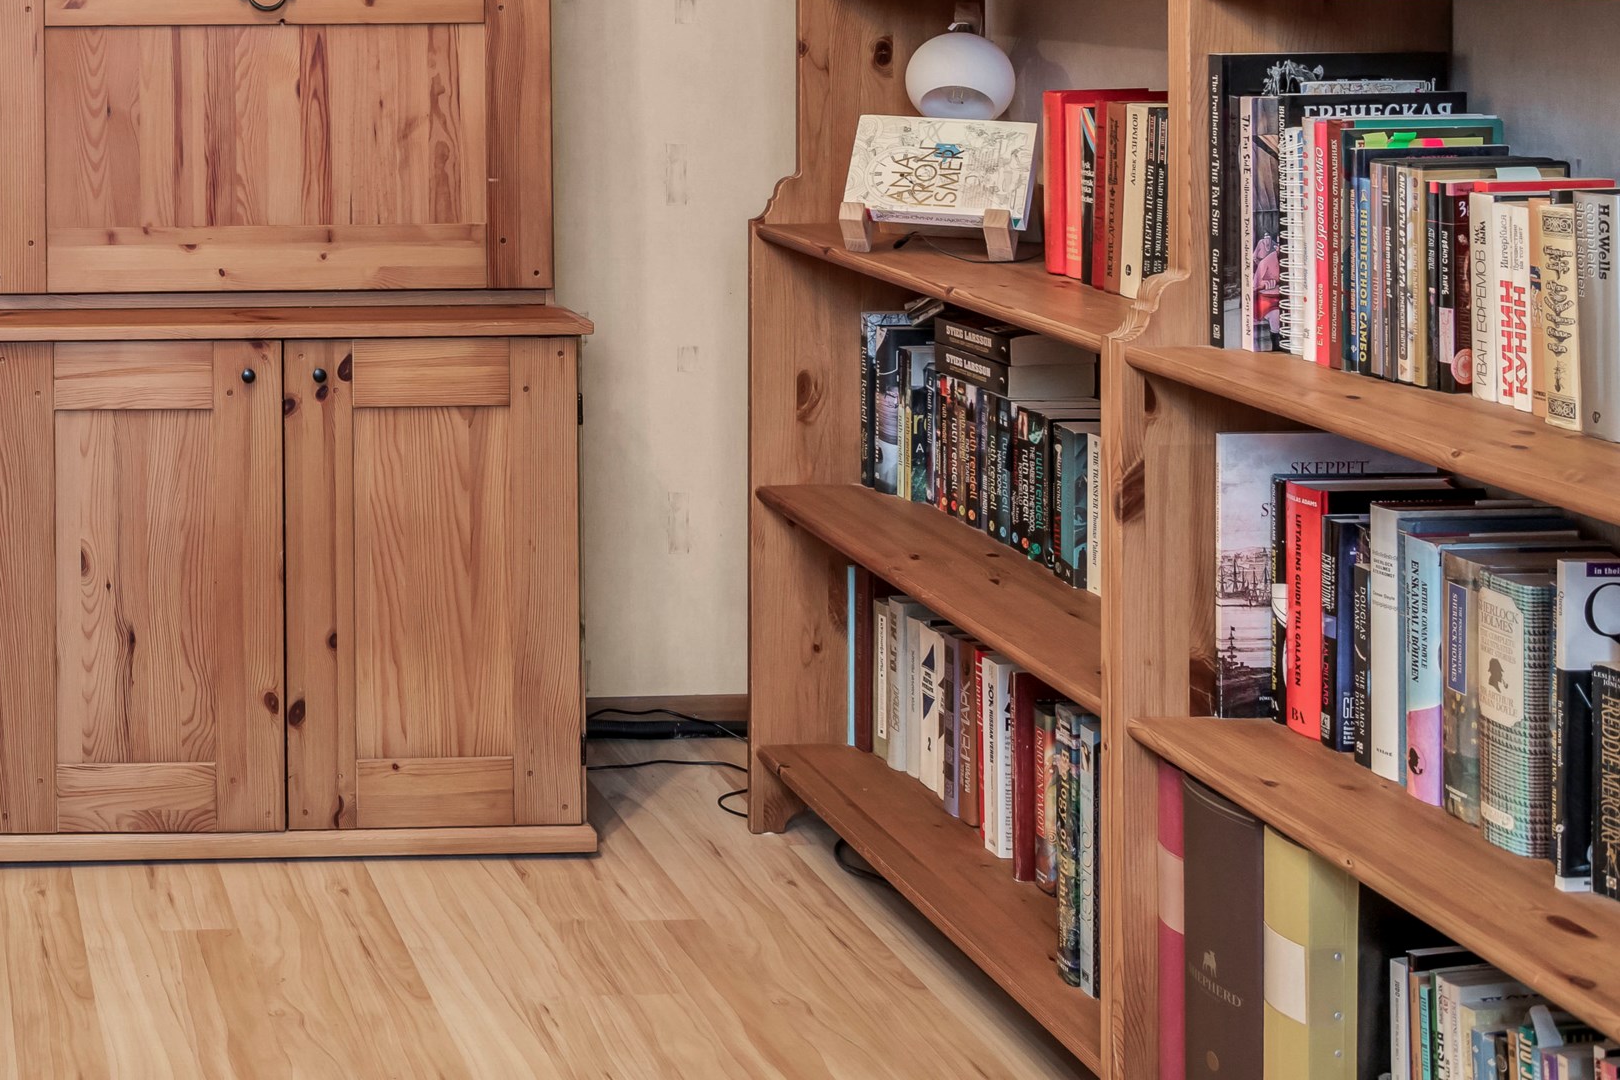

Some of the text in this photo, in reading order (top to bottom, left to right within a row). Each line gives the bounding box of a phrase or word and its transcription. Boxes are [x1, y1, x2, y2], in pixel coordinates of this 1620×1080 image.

[1212, 74, 1220, 94] The
[1304, 102, 1453, 119] ГРЕЧЕСКАЯ
[909, 146, 940, 208] KRON
[1211, 148, 1220, 158] of
[1212, 159, 1220, 183] THE
[887, 155, 917, 206] ANA
[932, 147, 965, 208] ISMER
[1212, 185, 1220, 206] FAR
[1145, 164, 1154, 257] СМЕРТЬ ЦЕЗАРЯ
[1212, 209, 1220, 237] SIDE
[1211, 248, 1220, 275] Gary
[1576, 200, 1585, 298] short stories
[1585, 202, 1596, 279] complete
[1212, 277, 1220, 316] Larson
[1359, 209, 1368, 362] НЕИЗВЕСТНОЕ САМБО
[946, 325, 992, 348] STIEG LARSSON
[1475, 249, 1487, 386] ИВАН ЕФРЕМОВ
[1500, 280, 1514, 397] КУНИН
[1514, 287, 1527, 395] КУНИН
[945, 353, 963, 368] STIEG
[963, 359, 991, 377] LARSSON
[1410, 559, 1420, 575] EN
[1410, 576, 1420, 627] SKANDAL
[1420, 580, 1428, 668] ARTHUR CONAN DOYLE
[1478, 598, 1520, 625] SHERLOCK
[1480, 611, 1514, 635] HOLMES
[1410, 635, 1420, 683] BÖHMEN
[926, 736, 932, 752] 2
[960, 681, 971, 762] РЕМАРК
[1035, 729, 1044, 834] OSHO ZEN TAROT
[1600, 694, 1620, 845] FREDDIE MERCURY
[1059, 828, 1070, 851] of
